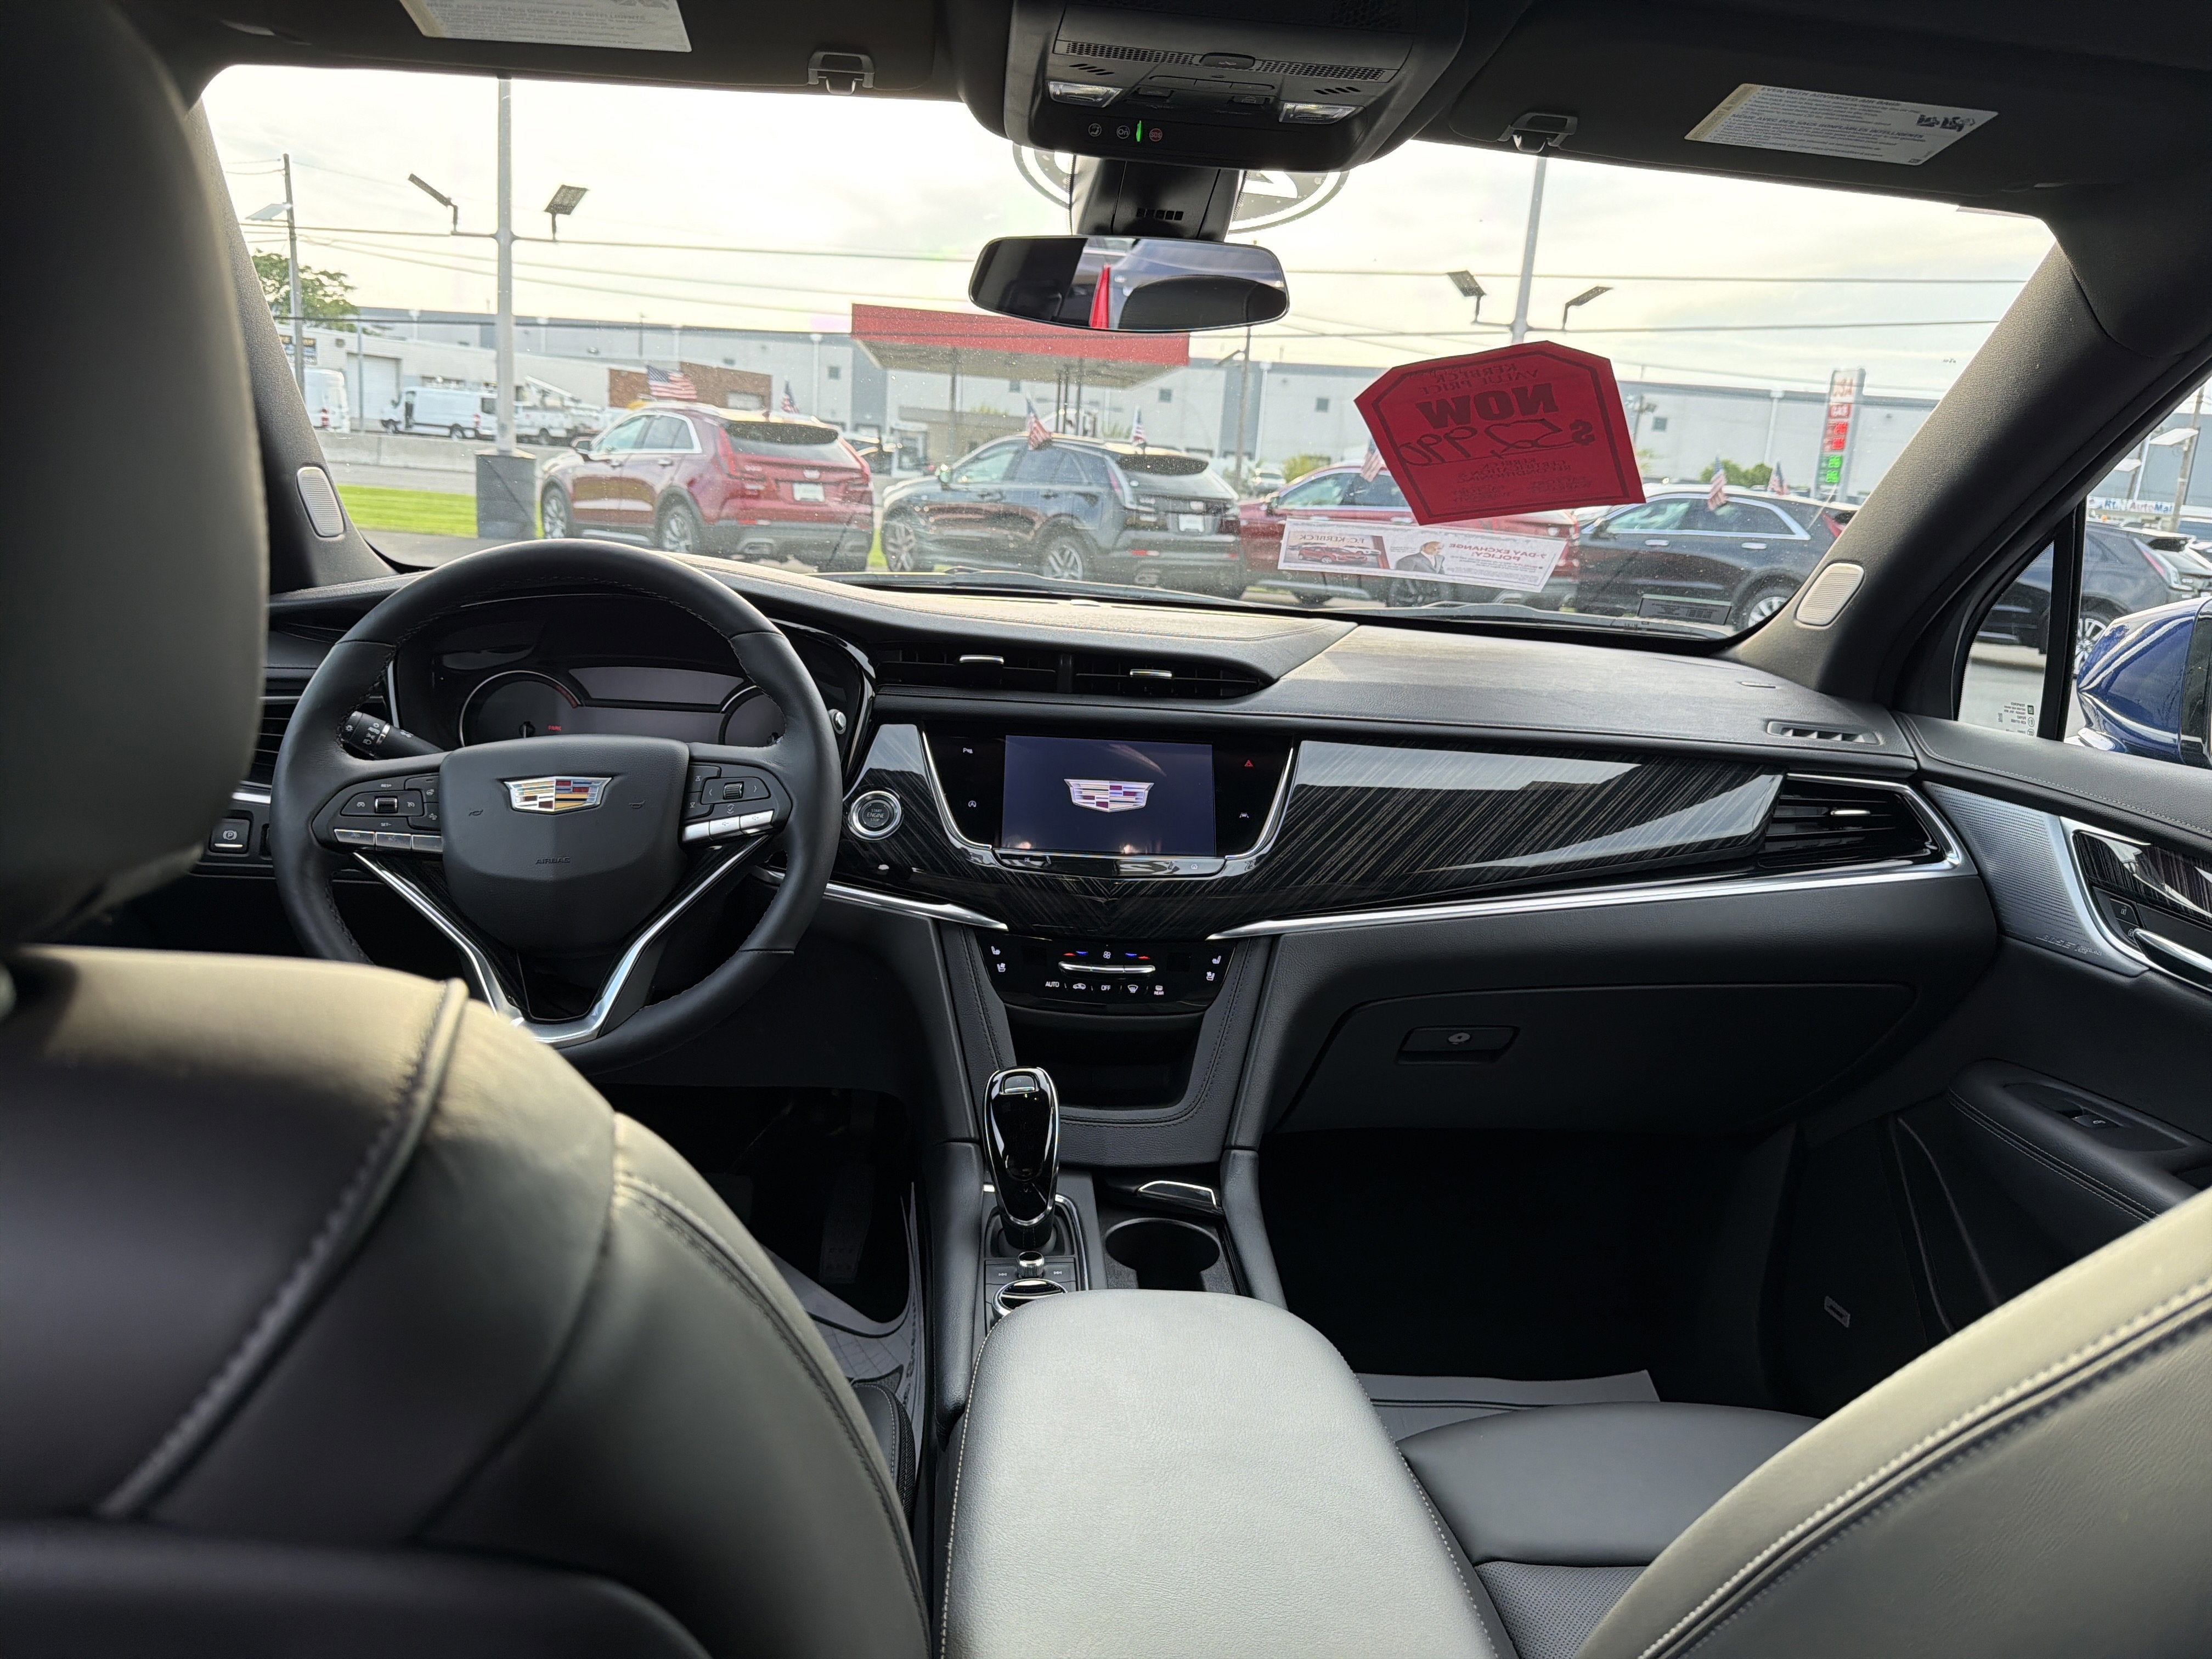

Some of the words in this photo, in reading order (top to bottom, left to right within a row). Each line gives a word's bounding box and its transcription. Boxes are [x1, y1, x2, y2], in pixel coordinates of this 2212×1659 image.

[2129, 502, 2172, 514] AutoMal
[367, 726, 381, 735] AUTO
[535, 856, 571, 865] AIRBAG
